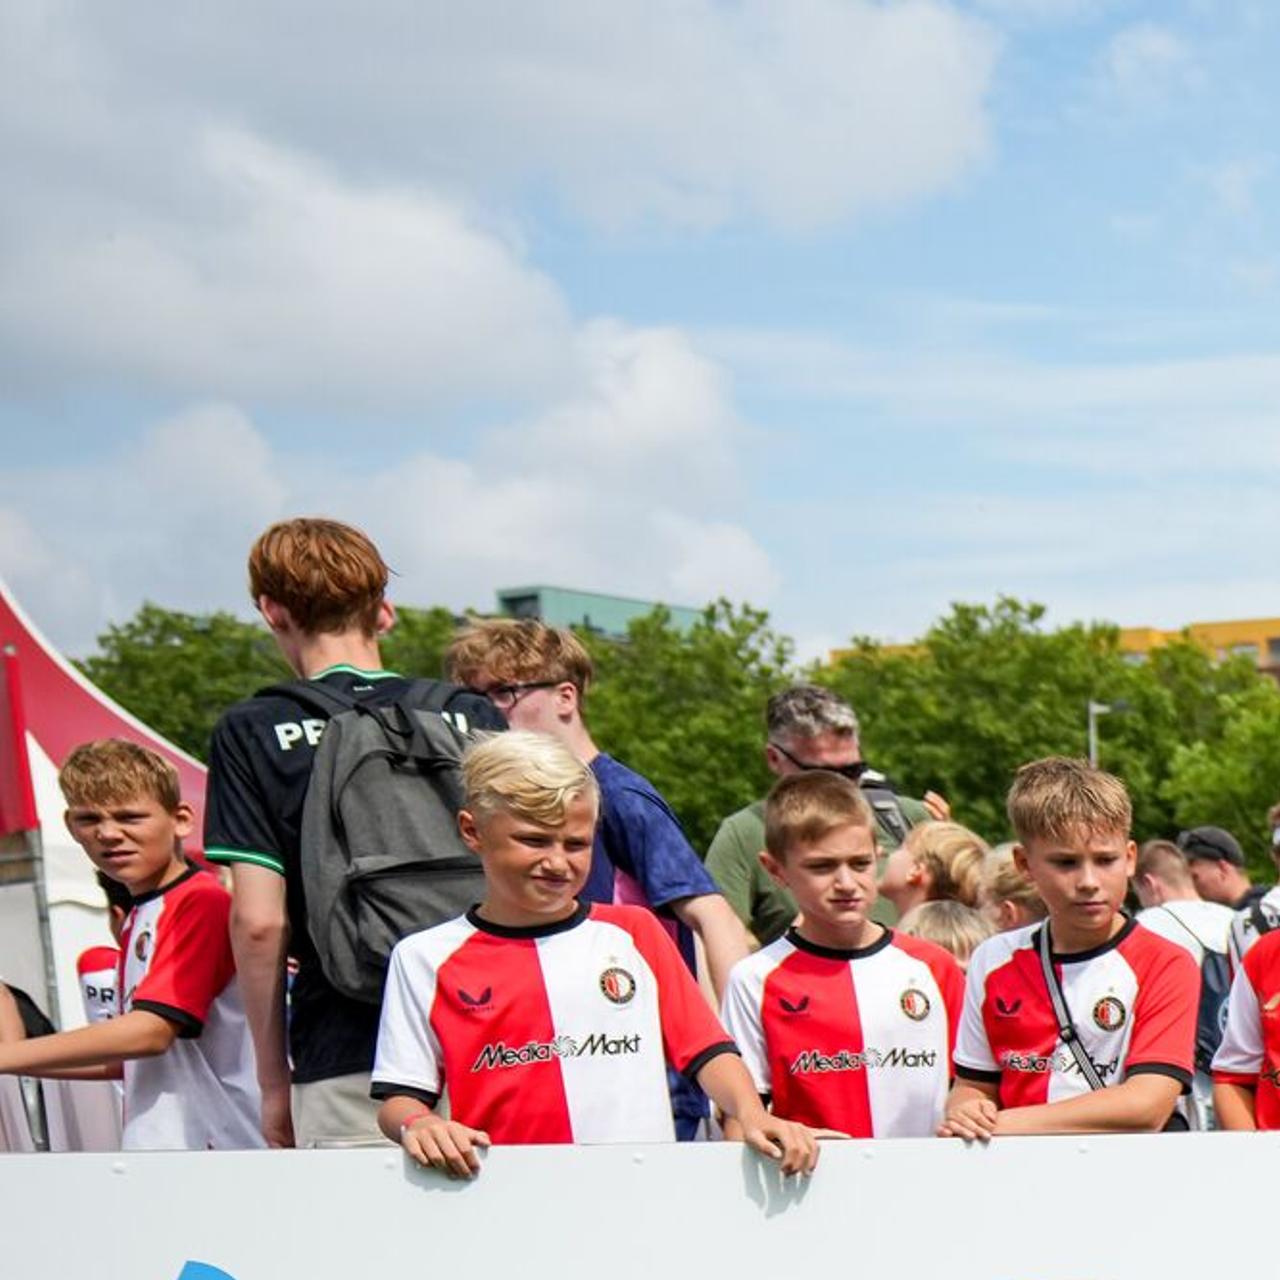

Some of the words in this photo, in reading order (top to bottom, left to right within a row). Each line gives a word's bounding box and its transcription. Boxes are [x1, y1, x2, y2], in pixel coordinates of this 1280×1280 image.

[472, 1043, 551, 1073] Media
[576, 1033, 642, 1057] Markt
[791, 1051, 862, 1074] Media
[881, 1047, 937, 1068] Markt
